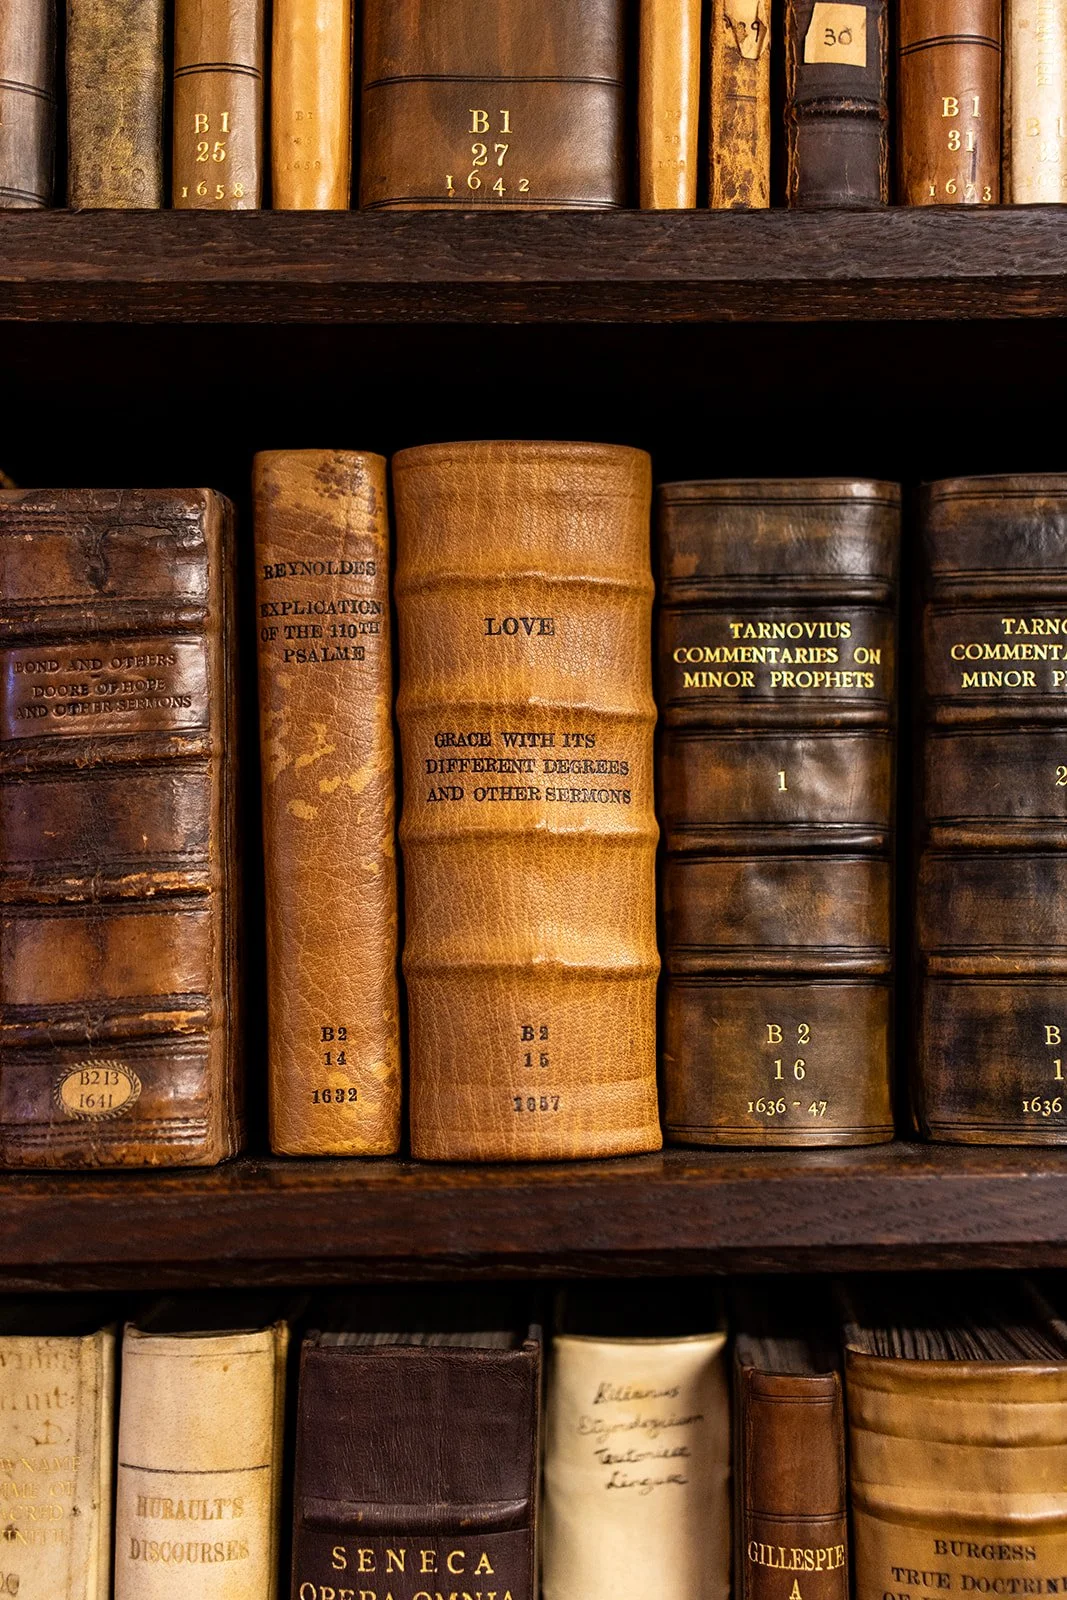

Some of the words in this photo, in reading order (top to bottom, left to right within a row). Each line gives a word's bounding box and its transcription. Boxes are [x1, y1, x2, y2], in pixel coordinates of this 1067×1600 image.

[824, 27, 853, 47] 30
[941, 96, 959, 118] B
[194, 113, 209, 134] B
[468, 109, 490, 134] B
[947, 129, 975, 152] 31
[196, 141, 227, 163] 25
[471, 142, 509, 167] 27
[181, 181, 244, 201] 1658
[445, 169, 531, 197] 1642
[929, 178, 992, 202] 1673
[263, 560, 377, 581] REYNOLDES
[259, 599, 384, 618] EXPLICATION
[260, 626, 279, 643] OF
[284, 624, 323, 640] THE
[484, 616, 556, 636] LOVE
[729, 621, 852, 640] TARNOVIUS
[283, 646, 365, 664] PSALME
[673, 646, 839, 665] COMMENTARIES
[853, 648, 881, 665] ON
[950, 643, 1067, 661] COMMENT
[65, 657, 104, 673] AND
[110, 653, 177, 671] OTHERS
[32, 684, 90, 700] DOORE
[95, 682, 119, 696] OF
[121, 678, 166, 693] HOPE
[683, 671, 756, 688] MINOR
[770, 671, 875, 689] PROPHETS
[961, 670, 1037, 688] MINOR
[1052, 670, 1067, 687] P
[16, 705, 49, 721] AND
[52, 701, 114, 717] OTHER
[116, 695, 193, 713] SERMONS
[433, 731, 492, 749] GRACE
[501, 732, 556, 748] WITH
[562, 733, 596, 749] ITS
[425, 757, 536, 775] DIFFERENT
[542, 758, 630, 776] DEGREES
[1055, 765, 1067, 786] 2
[776, 770, 788, 791] 1
[426, 785, 465, 803] AND
[473, 786, 541, 802] OTHER
[545, 786, 632, 804] SERMONS
[766, 1024, 783, 1045] B
[797, 1022, 810, 1045] 2
[1044, 1025, 1062, 1045] B
[323, 1050, 347, 1067] 14
[524, 1052, 550, 1068] 15
[1053, 1059, 1064, 1081] 1
[80, 1093, 113, 1108] 1641
[311, 1087, 358, 1105] 1632
[1022, 1096, 1063, 1117] 1636
[747, 1097, 787, 1117] 1636
[808, 1100, 828, 1118] 47
[129, 1536, 250, 1564] DISCOURSES
[747, 1540, 846, 1572] GILLESPIE
[933, 1538, 1038, 1562] BURGESS
[331, 1546, 495, 1576] SENECA
[891, 1566, 951, 1590] TRUE
[789, 1578, 803, 1600] A
